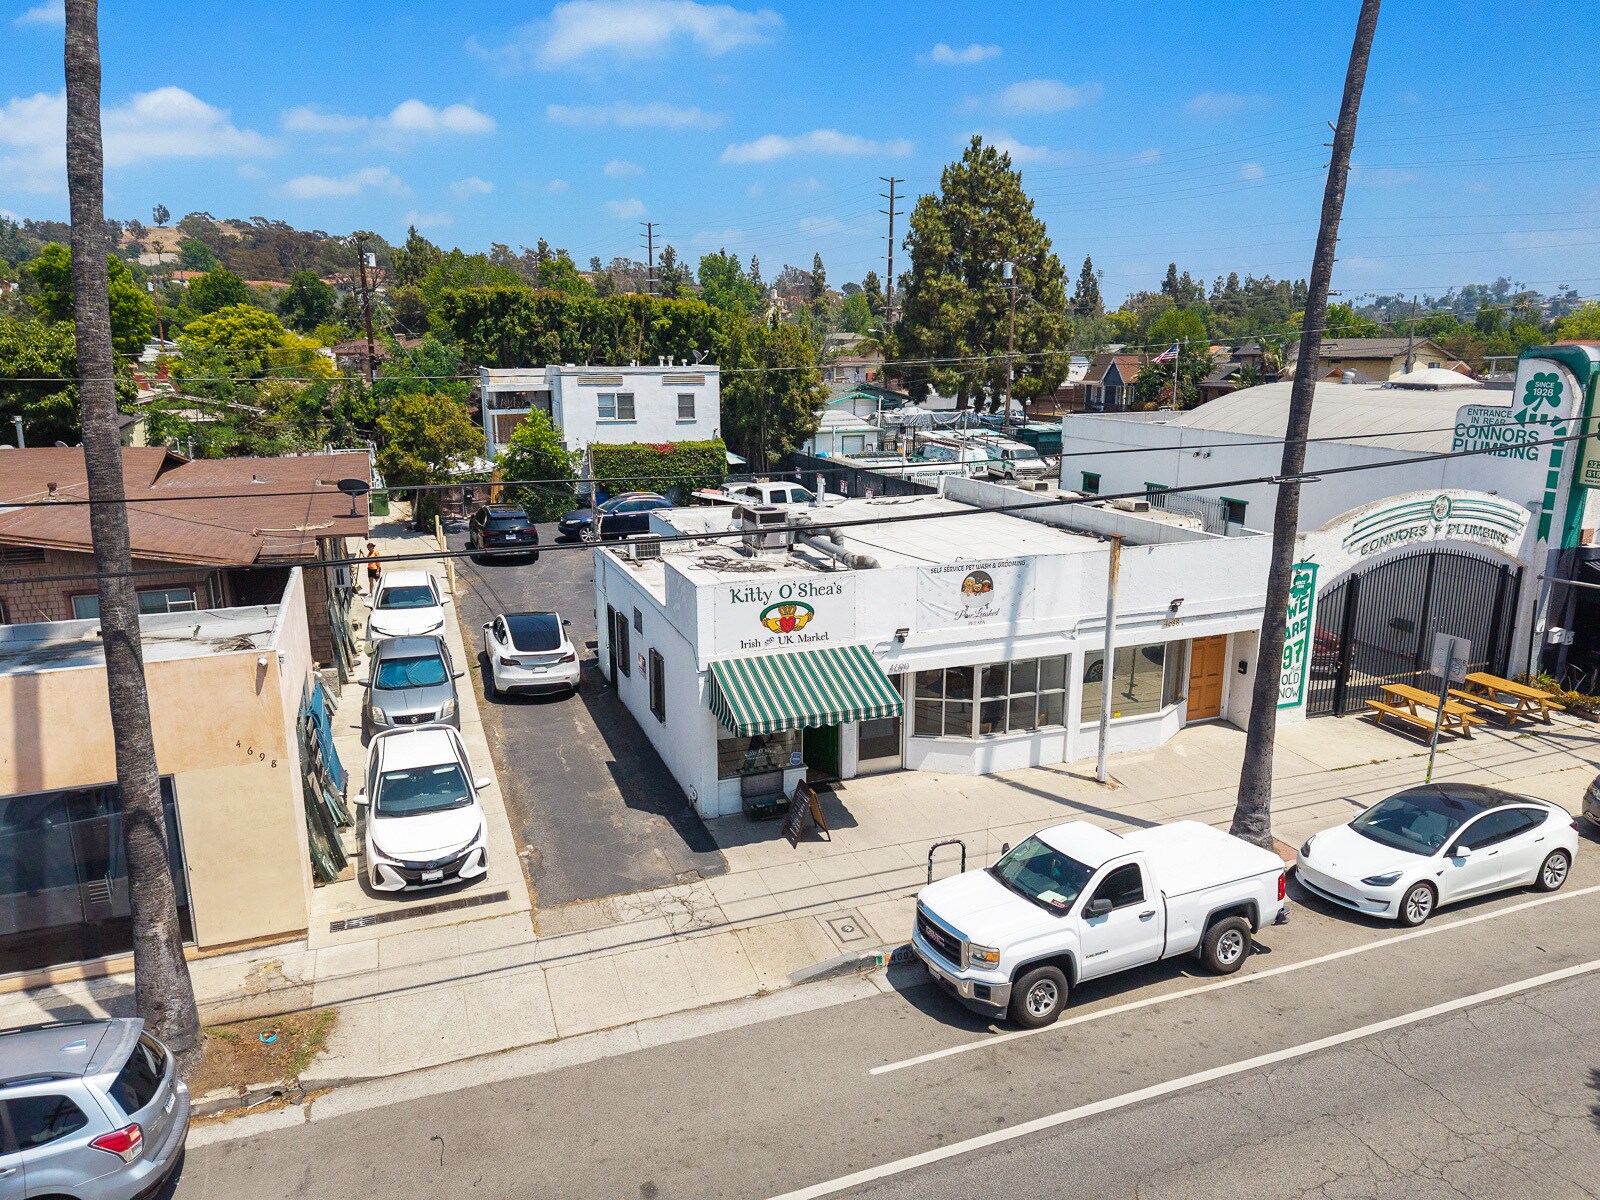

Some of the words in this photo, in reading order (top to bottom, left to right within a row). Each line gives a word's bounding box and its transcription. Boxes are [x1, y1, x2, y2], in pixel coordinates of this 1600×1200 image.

[1533, 388, 1554, 396] 1928
[1467, 408, 1513, 418] ENTRANCE
[1484, 417, 1506, 426] REAR
[1454, 423, 1539, 444] CONNORS
[1452, 438, 1539, 461] PLUMBING
[1361, 525, 1428, 555] CONNORS
[1446, 524, 1508, 544] PLUMBING
[943, 565, 964, 573] SERVICE
[997, 560, 1026, 568] GROOMING
[729, 587, 773, 605] Kitty
[779, 582, 842, 599] O'Shea's
[1287, 593, 1309, 619] WE
[740, 639, 761, 649] Irish
[778, 635, 794, 645] UK
[797, 632, 830, 643] Market
[1284, 617, 1307, 643] ARE
[1282, 639, 1304, 670] 97
[1281, 672, 1300, 685] OLD
[235, 740, 277, 769] 4698
